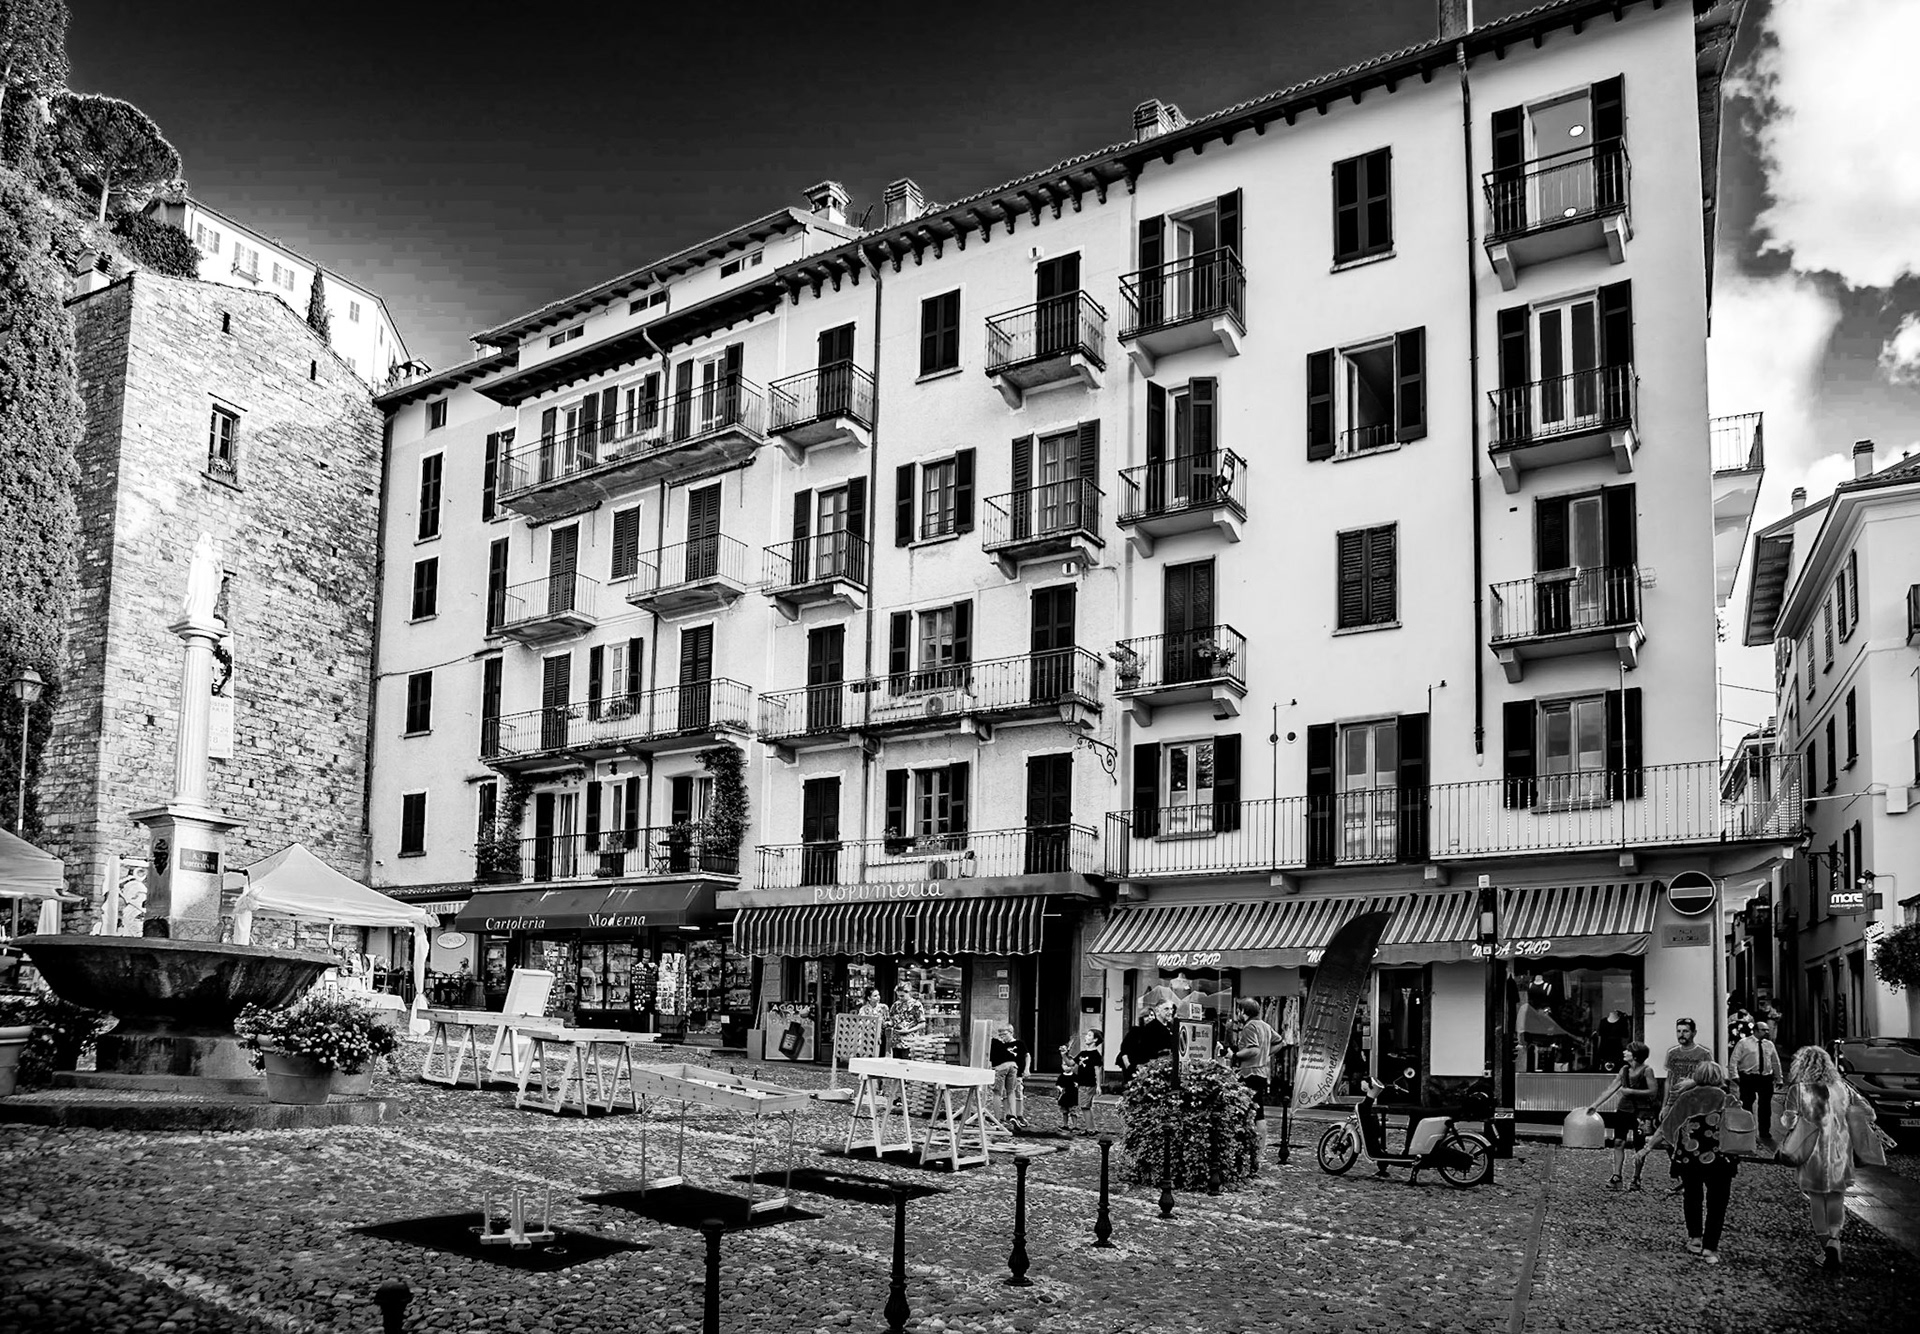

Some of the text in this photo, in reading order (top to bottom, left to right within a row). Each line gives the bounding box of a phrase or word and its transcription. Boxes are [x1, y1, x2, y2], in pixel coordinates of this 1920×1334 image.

[485, 913, 646, 931] Cartoleria Moderna
[1471, 939, 1551, 957] MDA SHOP
[1156, 952, 1222, 967] MODA SHOP
